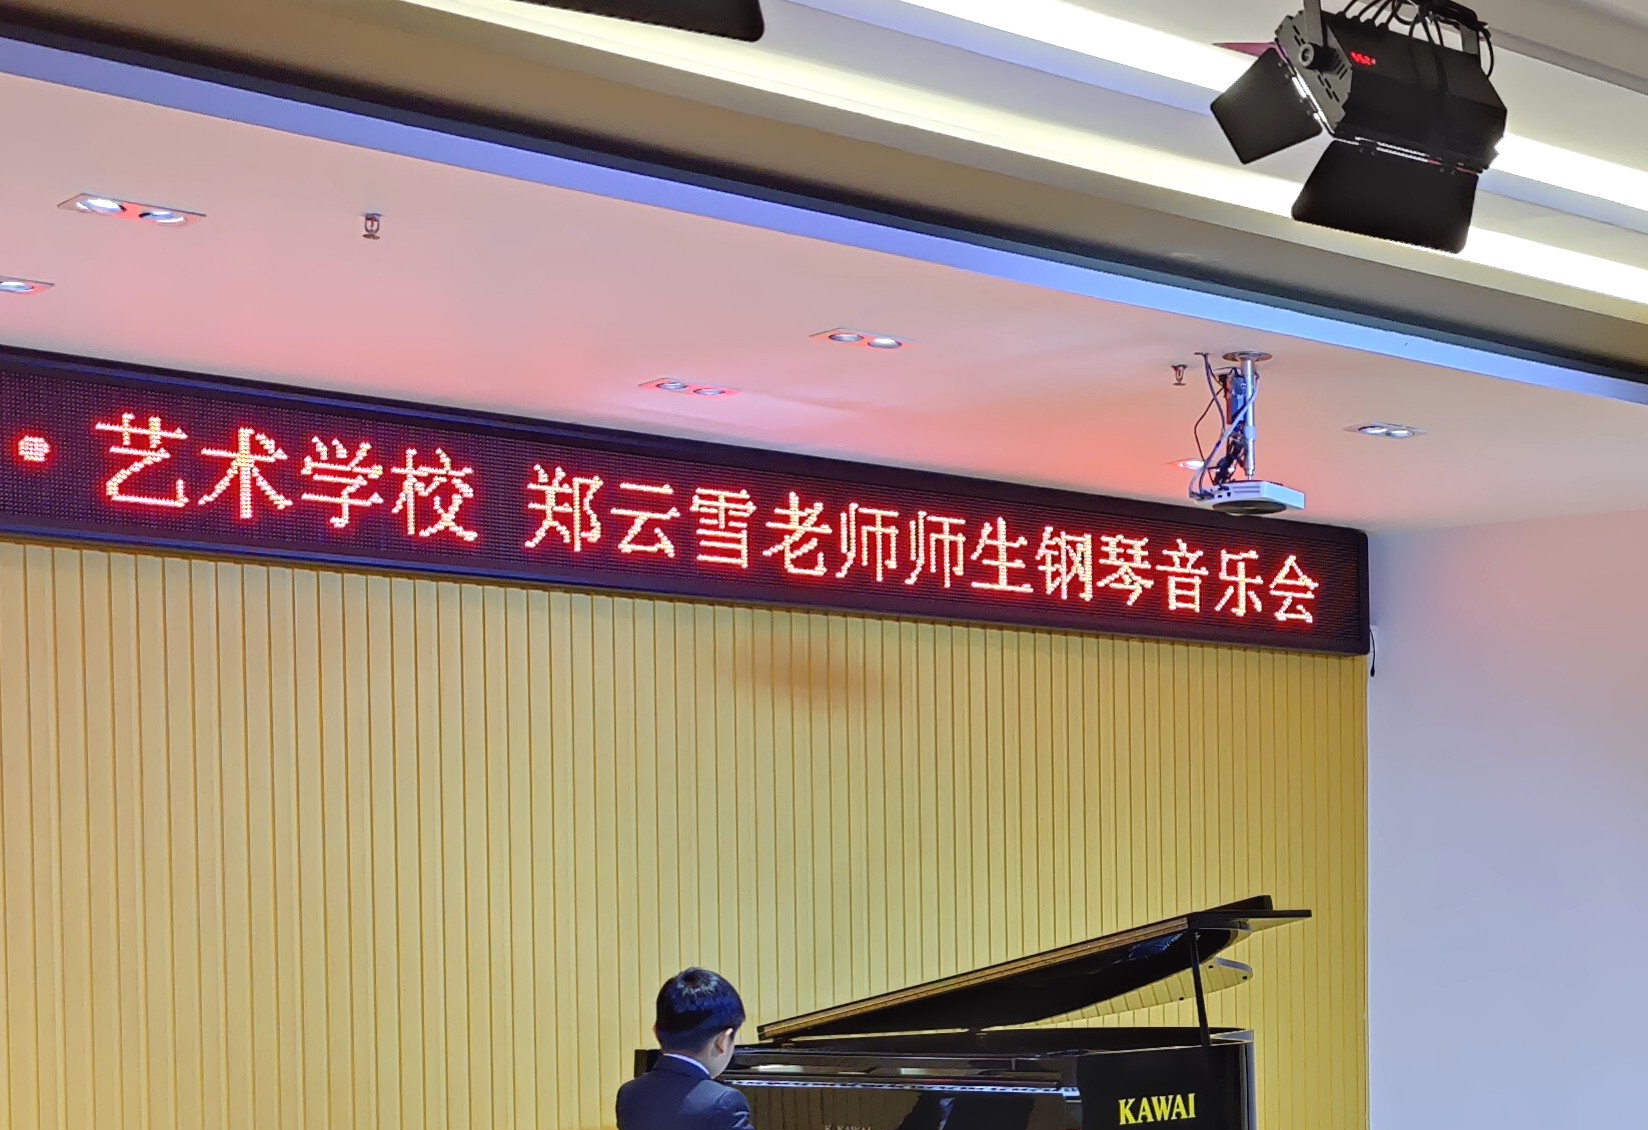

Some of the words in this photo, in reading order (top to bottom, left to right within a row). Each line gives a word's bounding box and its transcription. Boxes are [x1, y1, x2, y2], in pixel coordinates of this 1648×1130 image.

[524, 464, 1320, 626] 郑云雪老师师生钢琴音乐会
[1118, 1092, 1198, 1125] KAWAI
